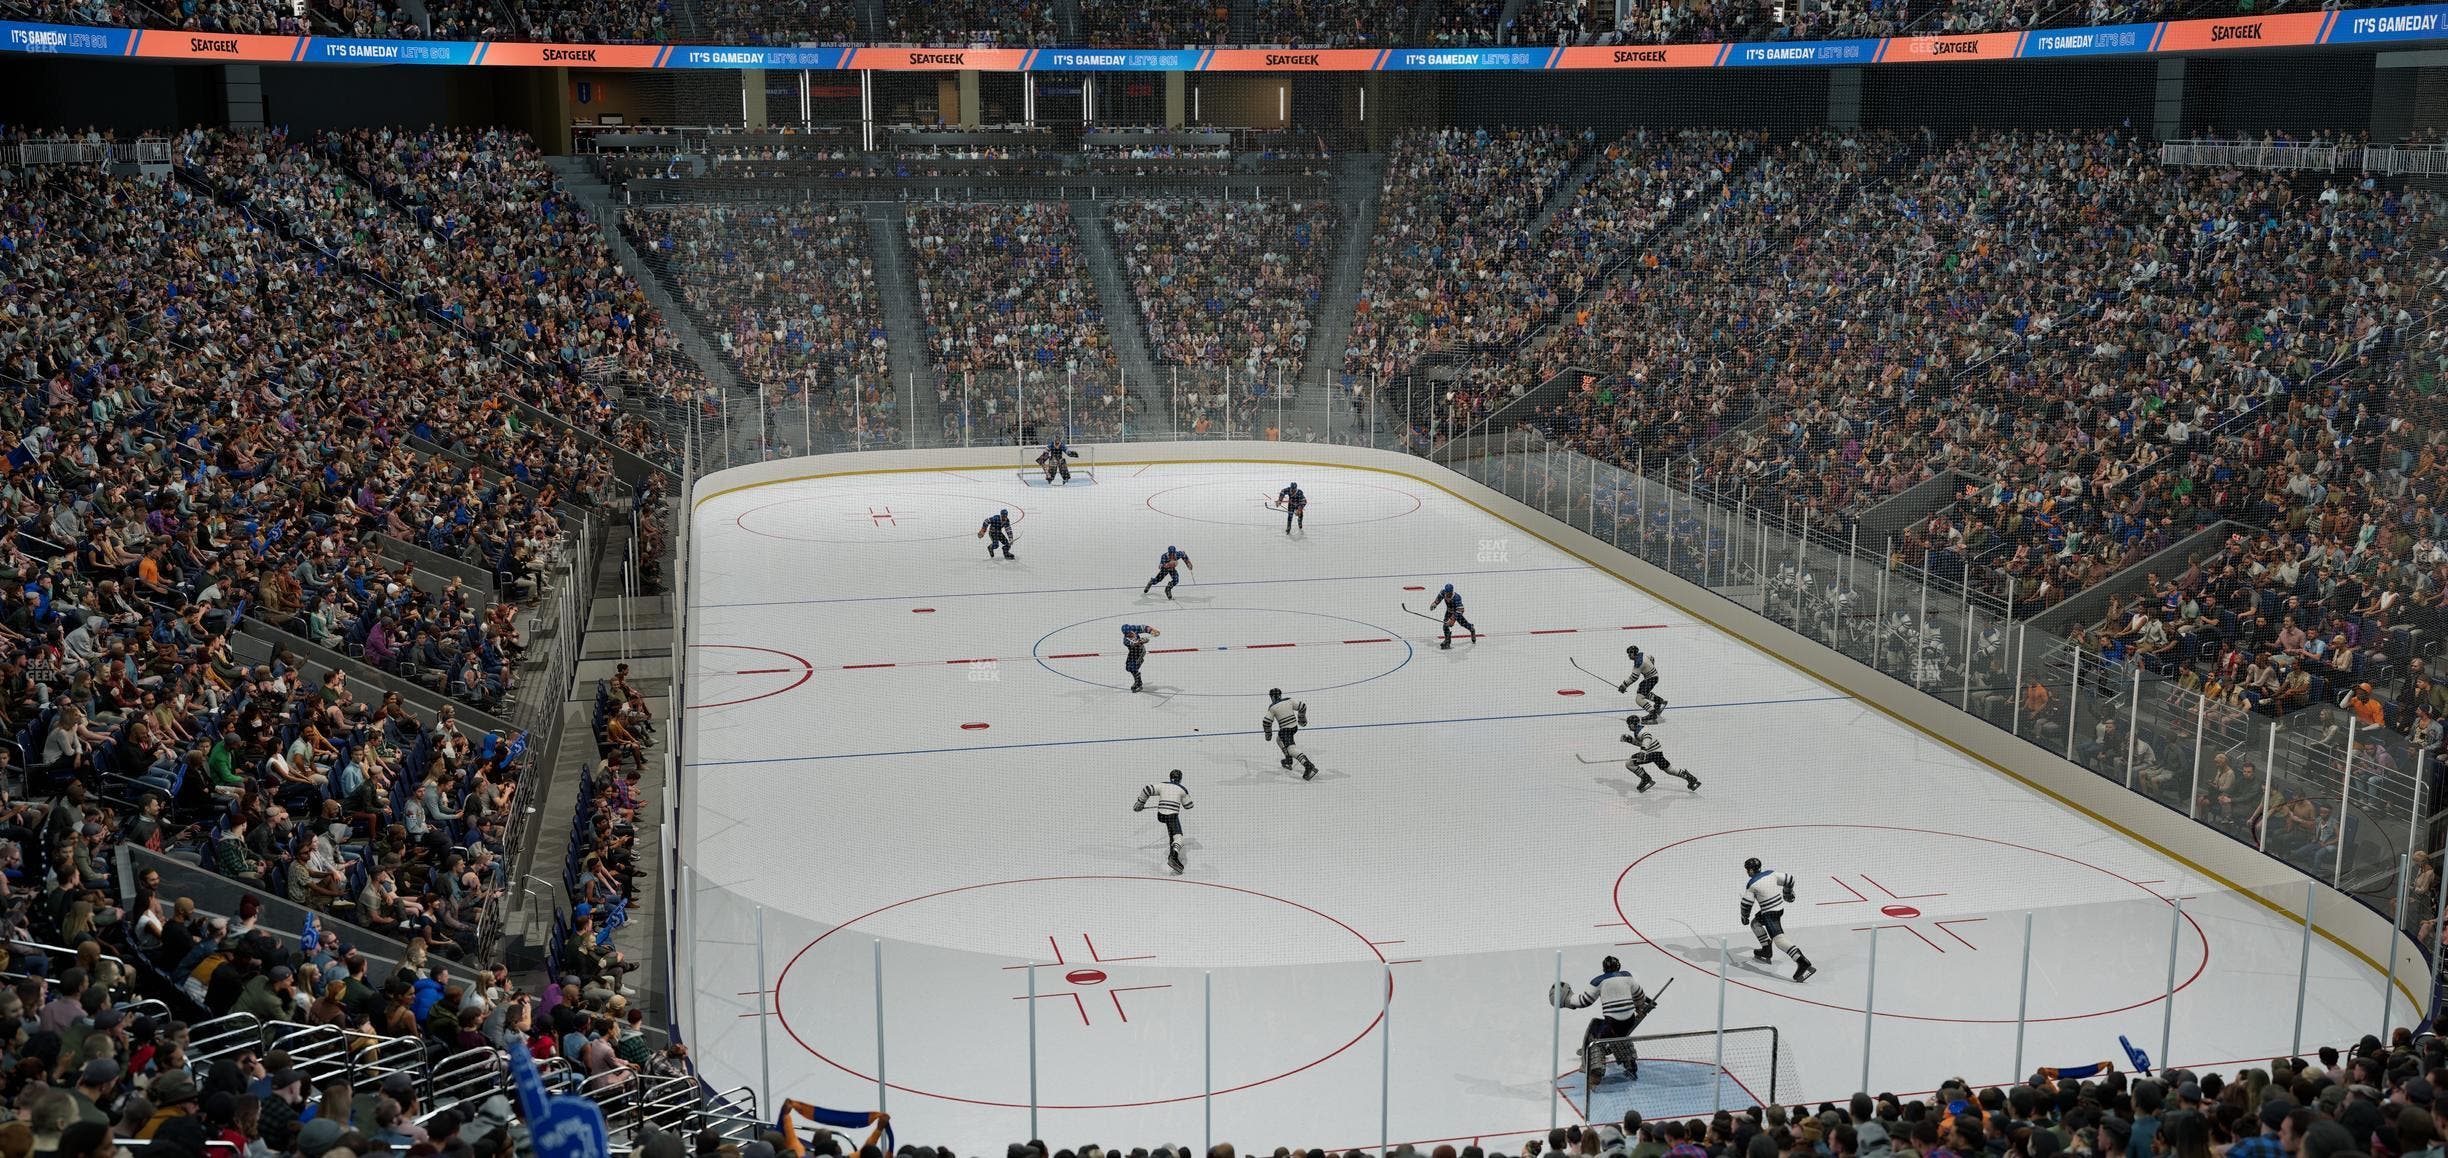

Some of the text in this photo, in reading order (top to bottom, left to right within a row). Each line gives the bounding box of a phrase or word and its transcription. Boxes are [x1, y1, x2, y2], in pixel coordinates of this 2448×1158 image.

[2354, 19, 2376, 34] IT'S
[2378, 15, 2438, 33] GAMEDAY
[12, 30, 28, 43] IT'S
[29, 31, 67, 46] GAMEDAY
[2212, 22, 2263, 42] SEATGEEK
[191, 38, 239, 54] SEATGEEK
[1933, 40, 1979, 55] SEATGEEK
[2039, 38, 2053, 50] IT'S
[2055, 36, 2094, 49] GAMEDAY
[327, 45, 347, 56] IT'S
[349, 46, 397, 57] GAMEDAY
[543, 49, 597, 62] SEATGEEK
[1614, 50, 1667, 63] SEATGEEK
[1746, 49, 1765, 60] IT'S
[1767, 48, 1816, 59] GAMEDAY
[690, 53, 710, 63] IT'S
[713, 53, 764, 63] GAMEDAY
[909, 53, 964, 65] SEATGEEK
[1054, 55, 1074, 65] IT'S
[1076, 55, 1126, 65] GAMEDAY
[1265, 54, 1319, 66] SEATGEEK
[1406, 55, 1426, 65] IT'S
[1428, 55, 1479, 65] GAMEDAY
